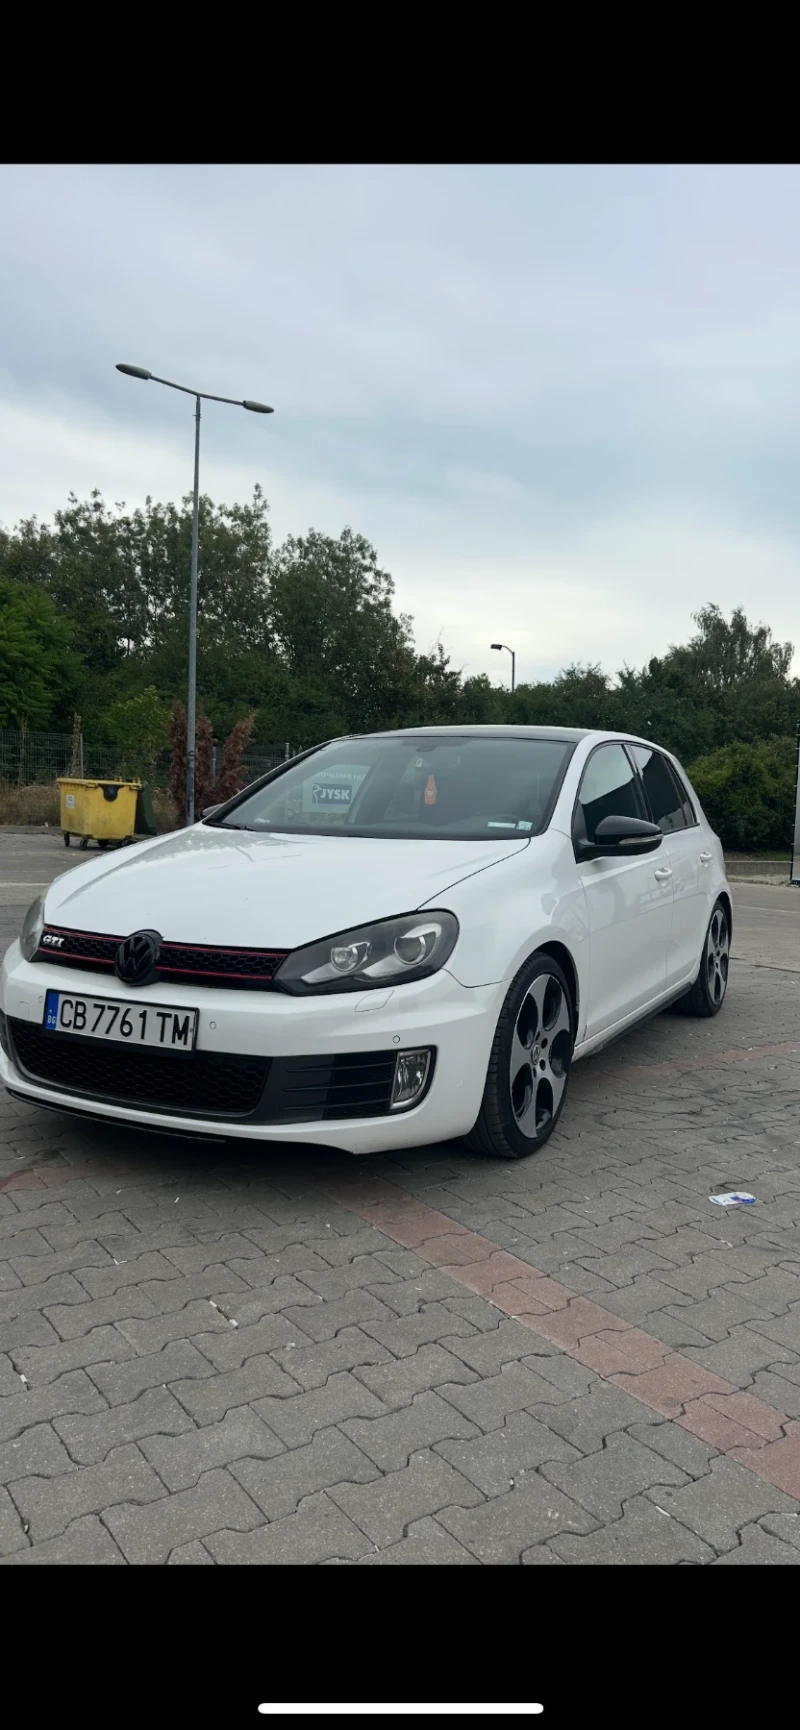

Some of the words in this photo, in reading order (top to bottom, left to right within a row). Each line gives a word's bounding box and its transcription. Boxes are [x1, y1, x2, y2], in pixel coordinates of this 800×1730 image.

[320, 788, 350, 800] JYSK
[43, 935, 64, 948] GTI
[47, 1014, 57, 1025] BG
